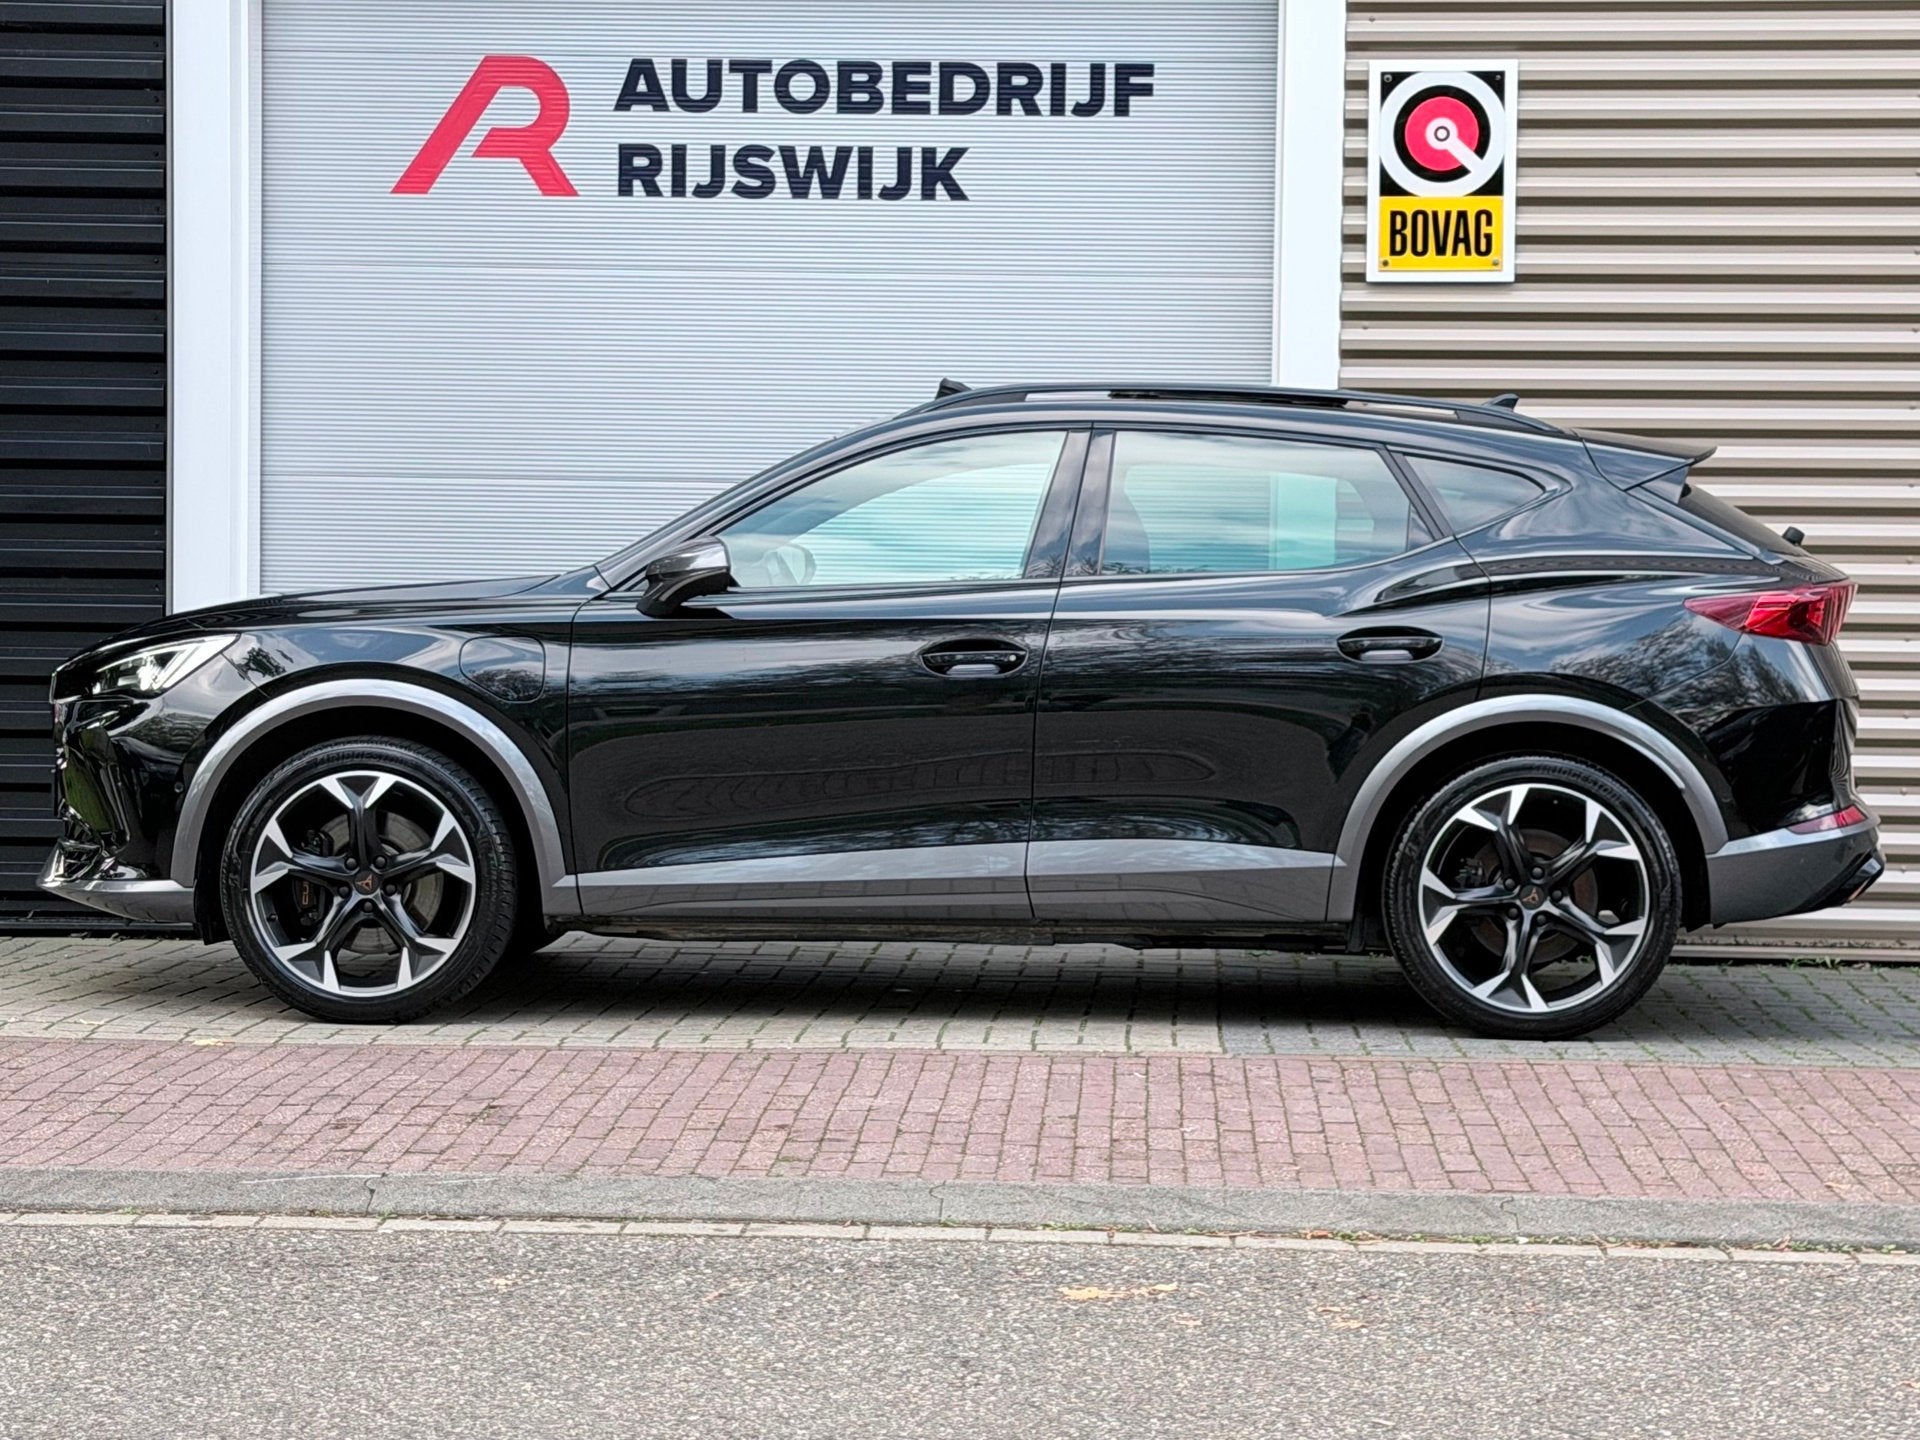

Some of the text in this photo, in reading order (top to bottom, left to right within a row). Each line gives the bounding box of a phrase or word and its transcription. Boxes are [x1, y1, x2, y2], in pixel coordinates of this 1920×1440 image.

[614, 58, 1154, 117] AUTOBEDRIJF
[618, 143, 968, 201] RIJSWIJK
[1389, 209, 1493, 257] BOVAG
